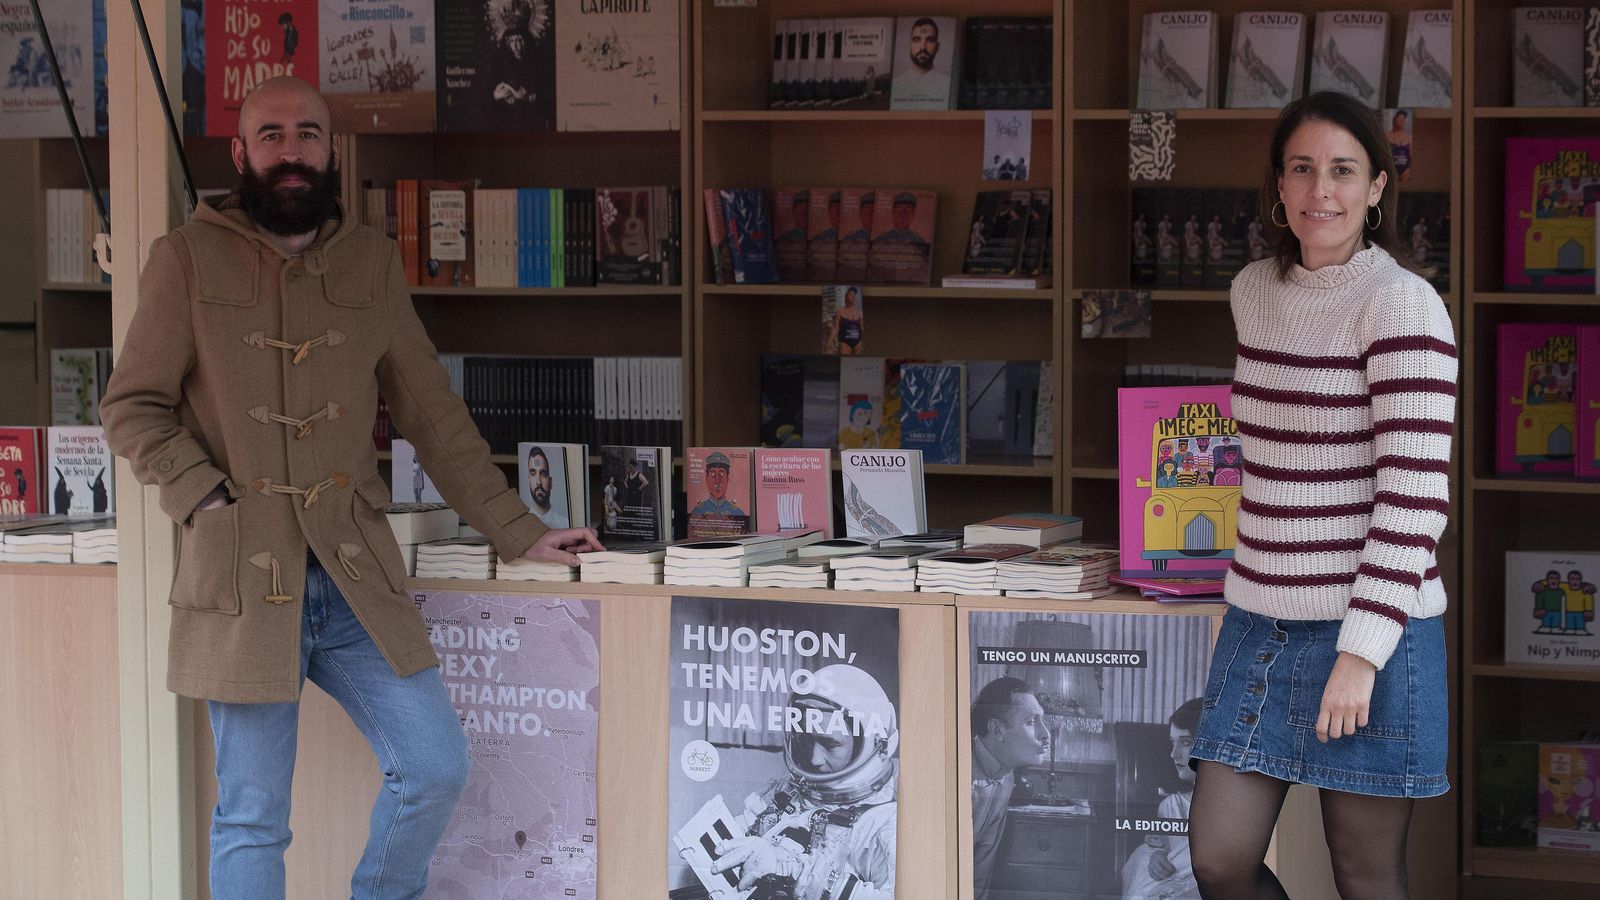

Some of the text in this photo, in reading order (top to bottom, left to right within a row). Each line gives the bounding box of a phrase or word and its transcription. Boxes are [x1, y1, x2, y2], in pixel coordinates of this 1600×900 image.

[580, 0, 651, 14] CAPIROTE
[1160, 13, 1207, 25] CANIJO
[1249, 14, 1298, 25] CANIJO
[1332, 13, 1384, 25] CANIJO
[1424, 12, 1452, 23] CAN
[1526, 9, 1581, 20] CANIJO
[227, 35, 271, 60] DE SU
[331, 52, 354, 67] A LA
[328, 66, 363, 84] CALLE!
[1558, 150, 1587, 161] TAXI
[1181, 404, 1216, 418] TAXI
[87, 445, 96, 454] de
[56, 455, 102, 465] Semana Santa
[782, 455, 806, 463] acabar
[850, 455, 906, 467] CANIJO
[64, 467, 95, 476] de Sevilla
[802, 462, 810, 470] de
[811, 462, 822, 470] las
[762, 470, 789, 478] mujeres
[425, 616, 463, 626] Manchester
[429, 626, 521, 652] ADING
[683, 624, 857, 664] HUOSTON,
[1527, 644, 1550, 657] Nip
[1554, 648, 1562, 659] y
[982, 650, 1140, 666] TENGO UN MANUSCRITO
[681, 662, 835, 695] TENEMOS
[444, 682, 587, 712] THAMPTON
[683, 700, 888, 739] UNA ERRATA
[470, 738, 510, 747] LATERRA
[1115, 819, 1132, 830] LA
[558, 845, 585, 854] Londres
